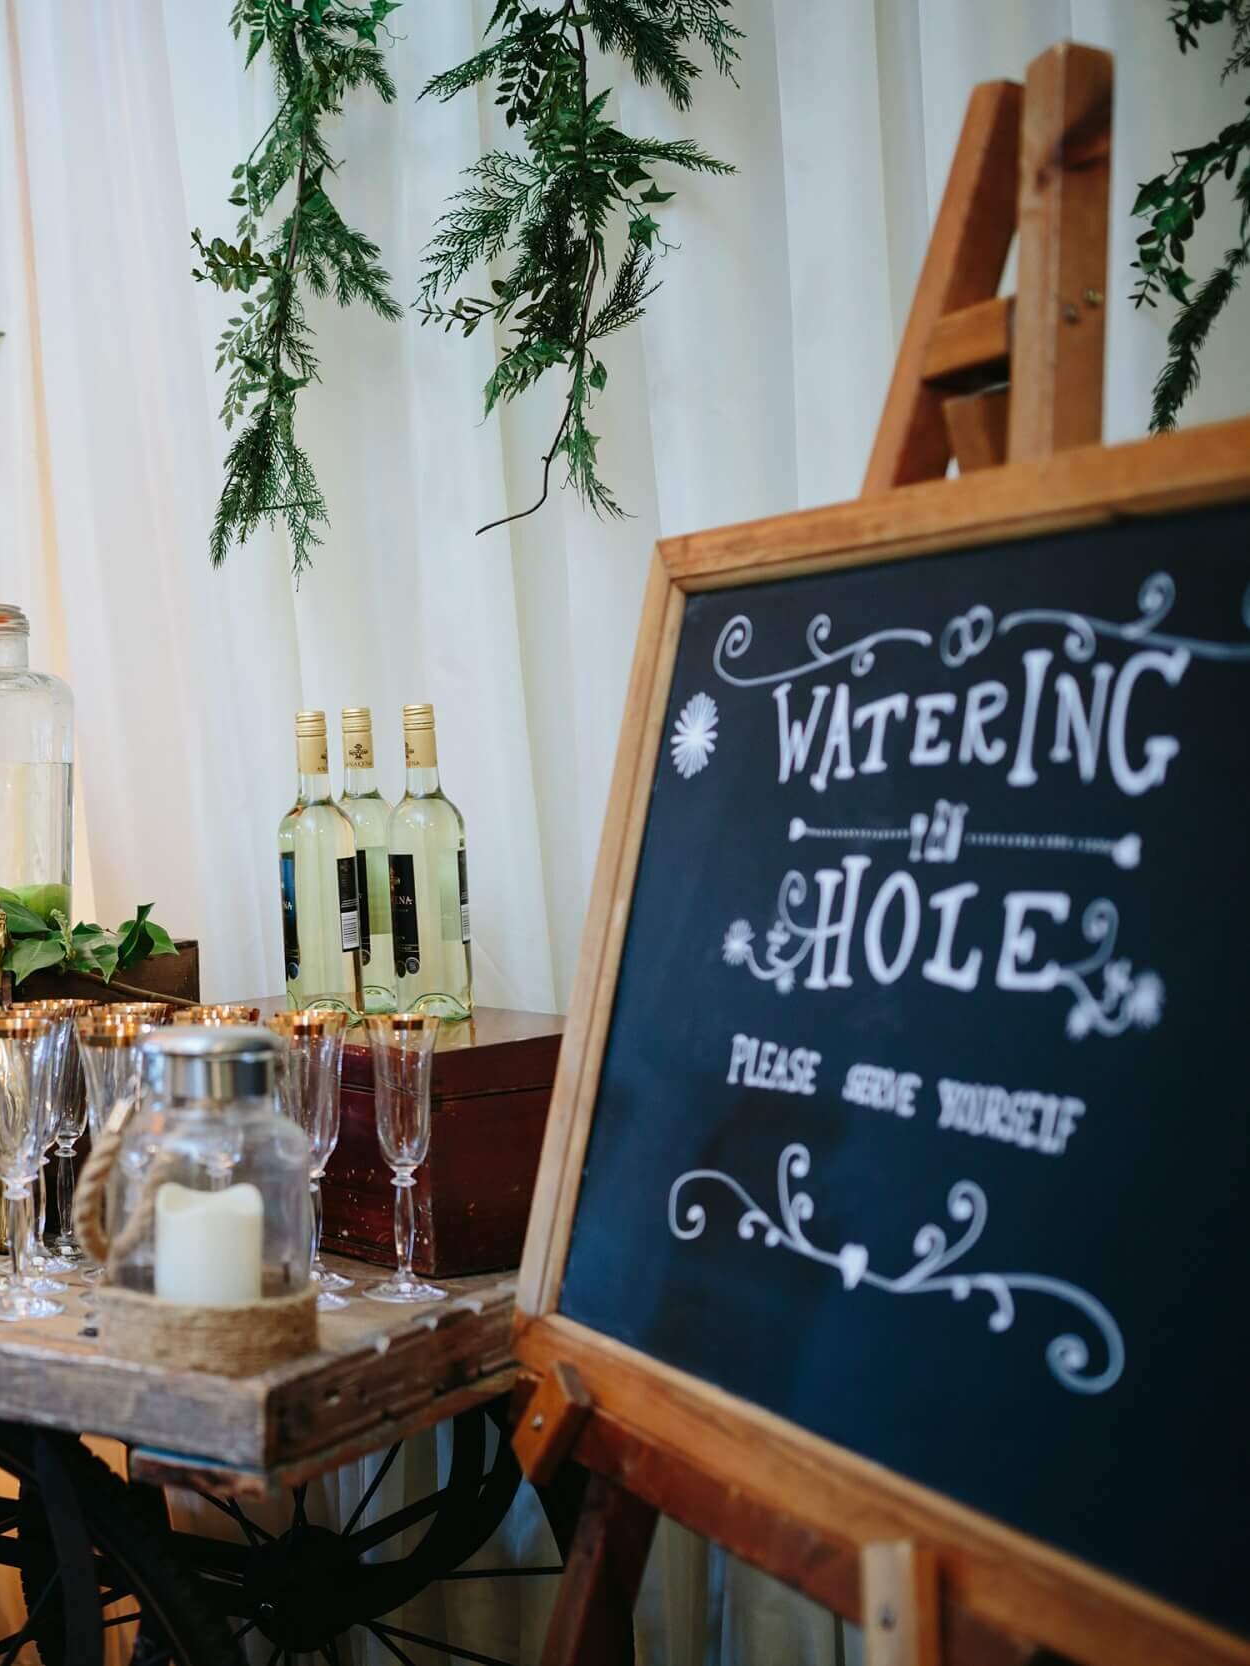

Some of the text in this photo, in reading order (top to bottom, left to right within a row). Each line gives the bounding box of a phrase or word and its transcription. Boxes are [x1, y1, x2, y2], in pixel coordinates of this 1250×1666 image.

[773, 648, 1191, 797] WATERING
[803, 856, 1071, 991] HOLE
[726, 1033, 1086, 1155] PLEASE SERVE YOURSELF
